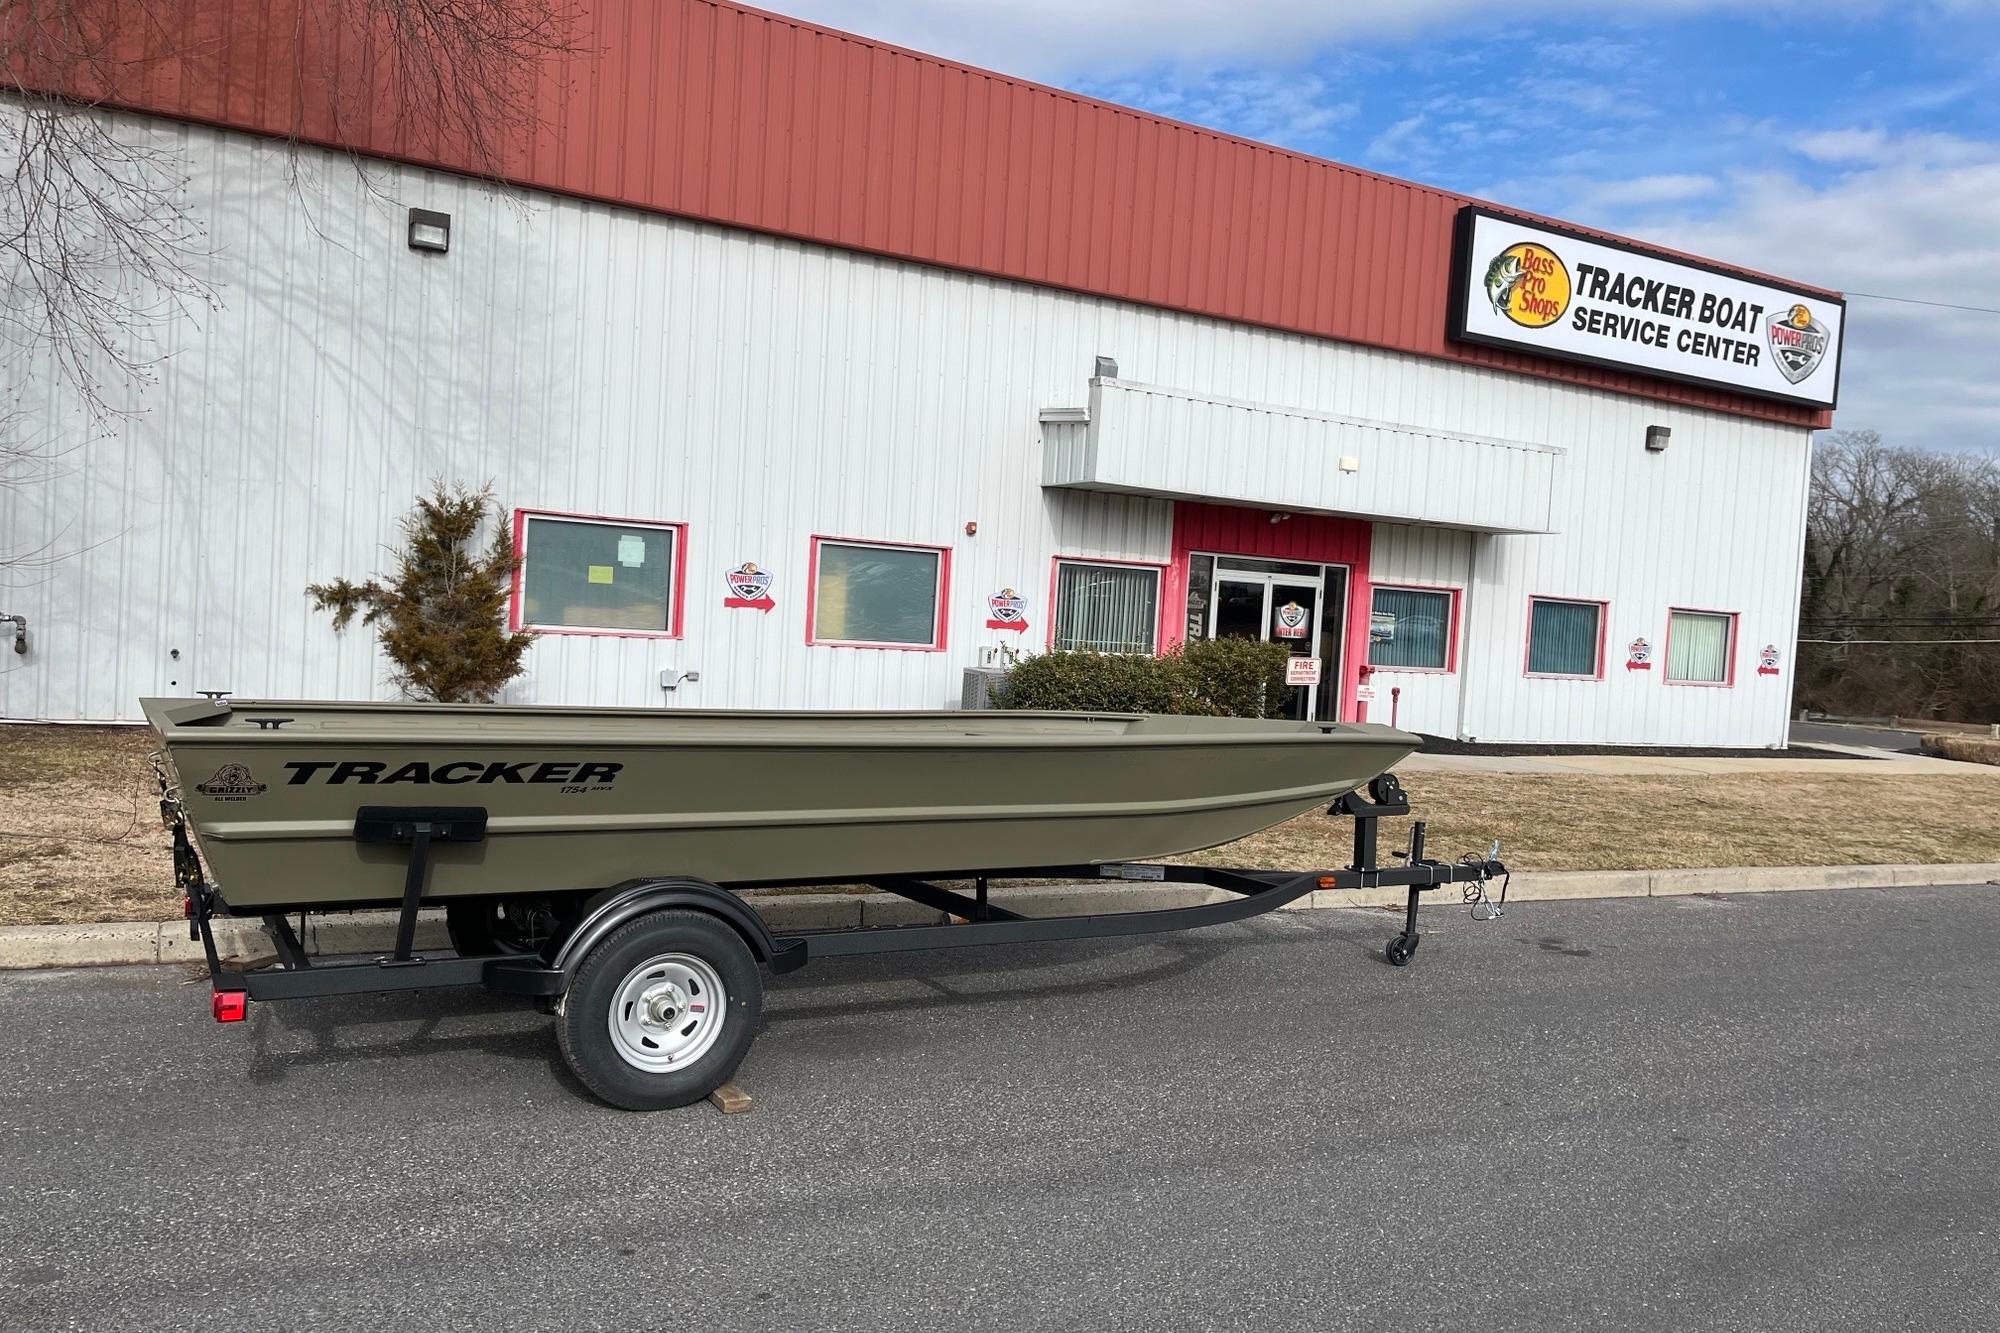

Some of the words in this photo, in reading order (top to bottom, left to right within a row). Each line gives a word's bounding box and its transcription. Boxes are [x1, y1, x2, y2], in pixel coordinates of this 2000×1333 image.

[1522, 248, 1555, 275] Bass
[1521, 270, 1546, 294] Pro
[1519, 290, 1559, 321] Shops
[1576, 263, 1695, 320] TRACKER
[1698, 293, 1764, 334] BOAT
[1572, 306, 1670, 349] SERVICE
[1677, 329, 1761, 367] CENTER
[1772, 325, 1824, 354] POWERPROS
[730, 574, 769, 585] POWERPROS
[1294, 661, 1314, 670] FIRE
[283, 761, 624, 785] TRACKER
[560, 786, 588, 794] 1754
